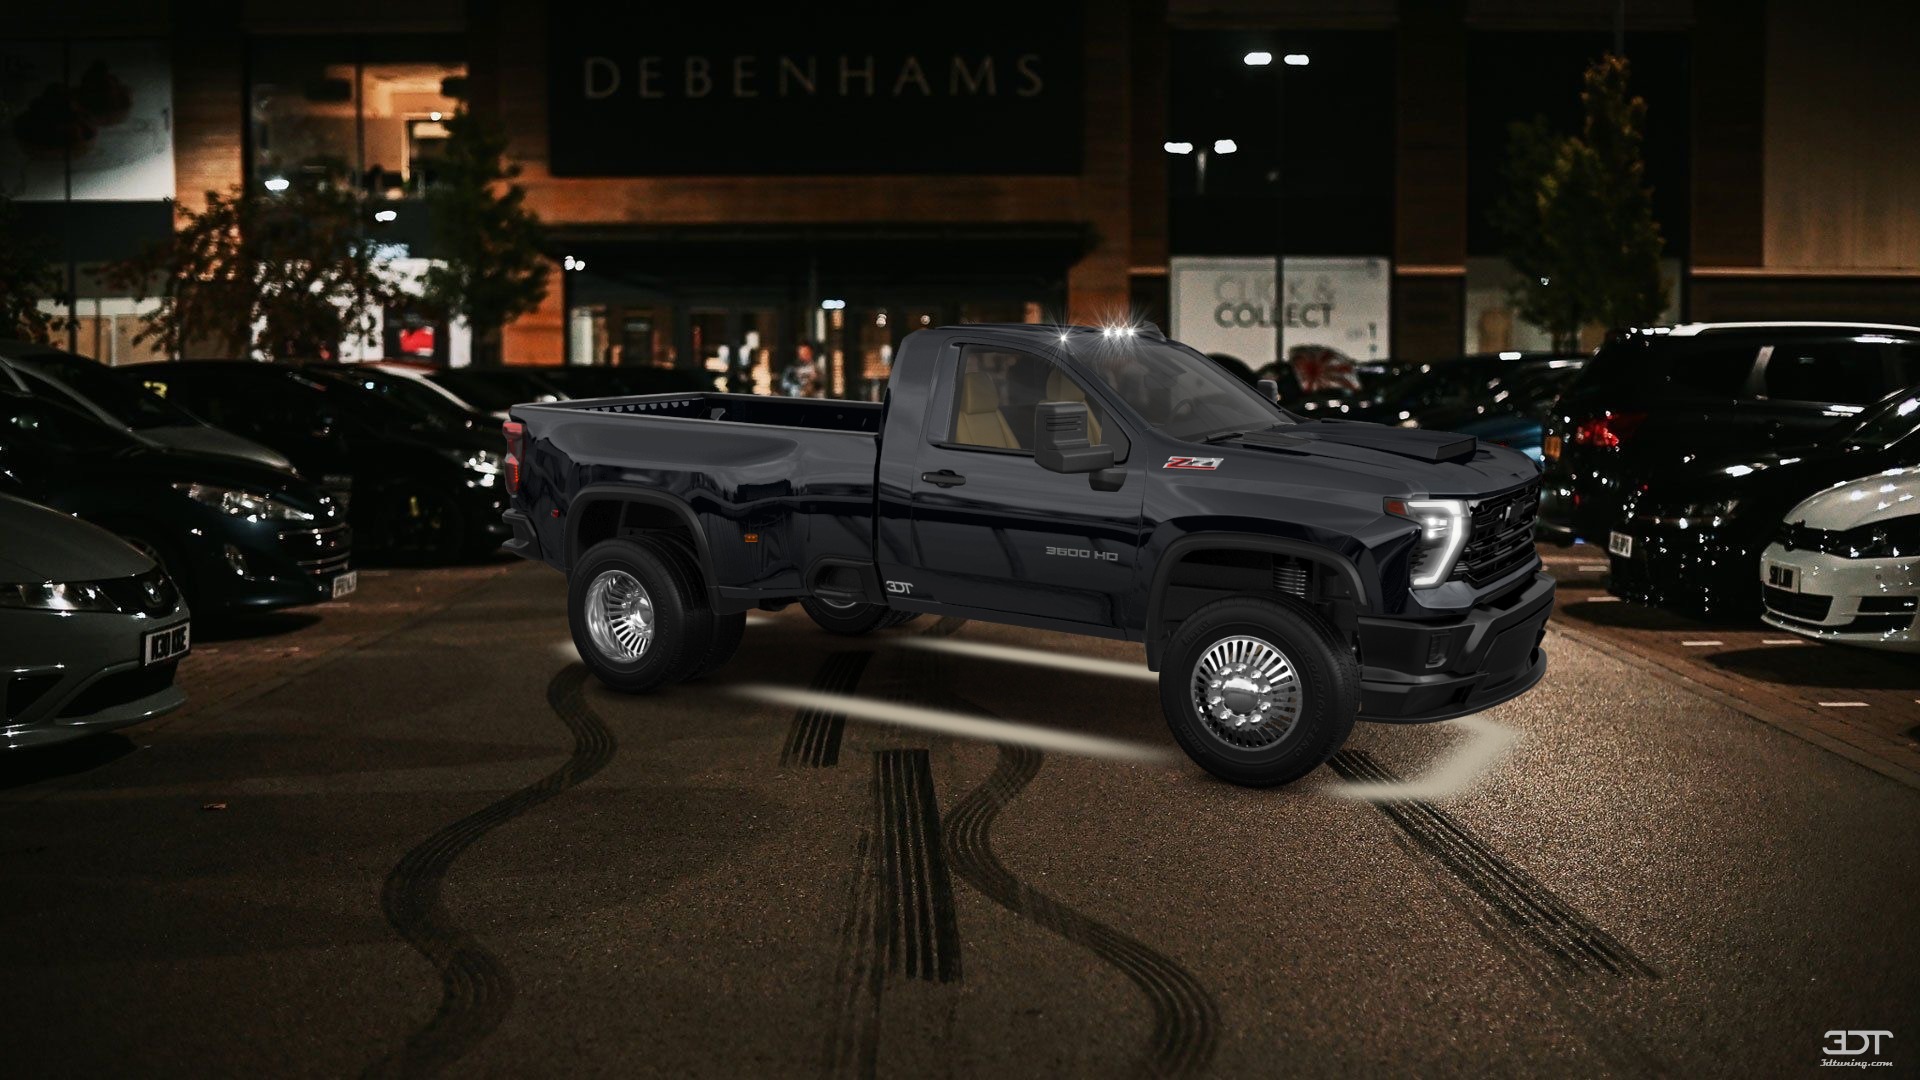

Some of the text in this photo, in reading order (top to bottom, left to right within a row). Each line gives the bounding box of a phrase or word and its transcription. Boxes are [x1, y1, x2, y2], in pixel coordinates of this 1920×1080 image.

[584, 54, 1044, 99] DEBENHAMS
[1214, 302, 1333, 328] COLLECT
[1094, 550, 1118, 561] HD
